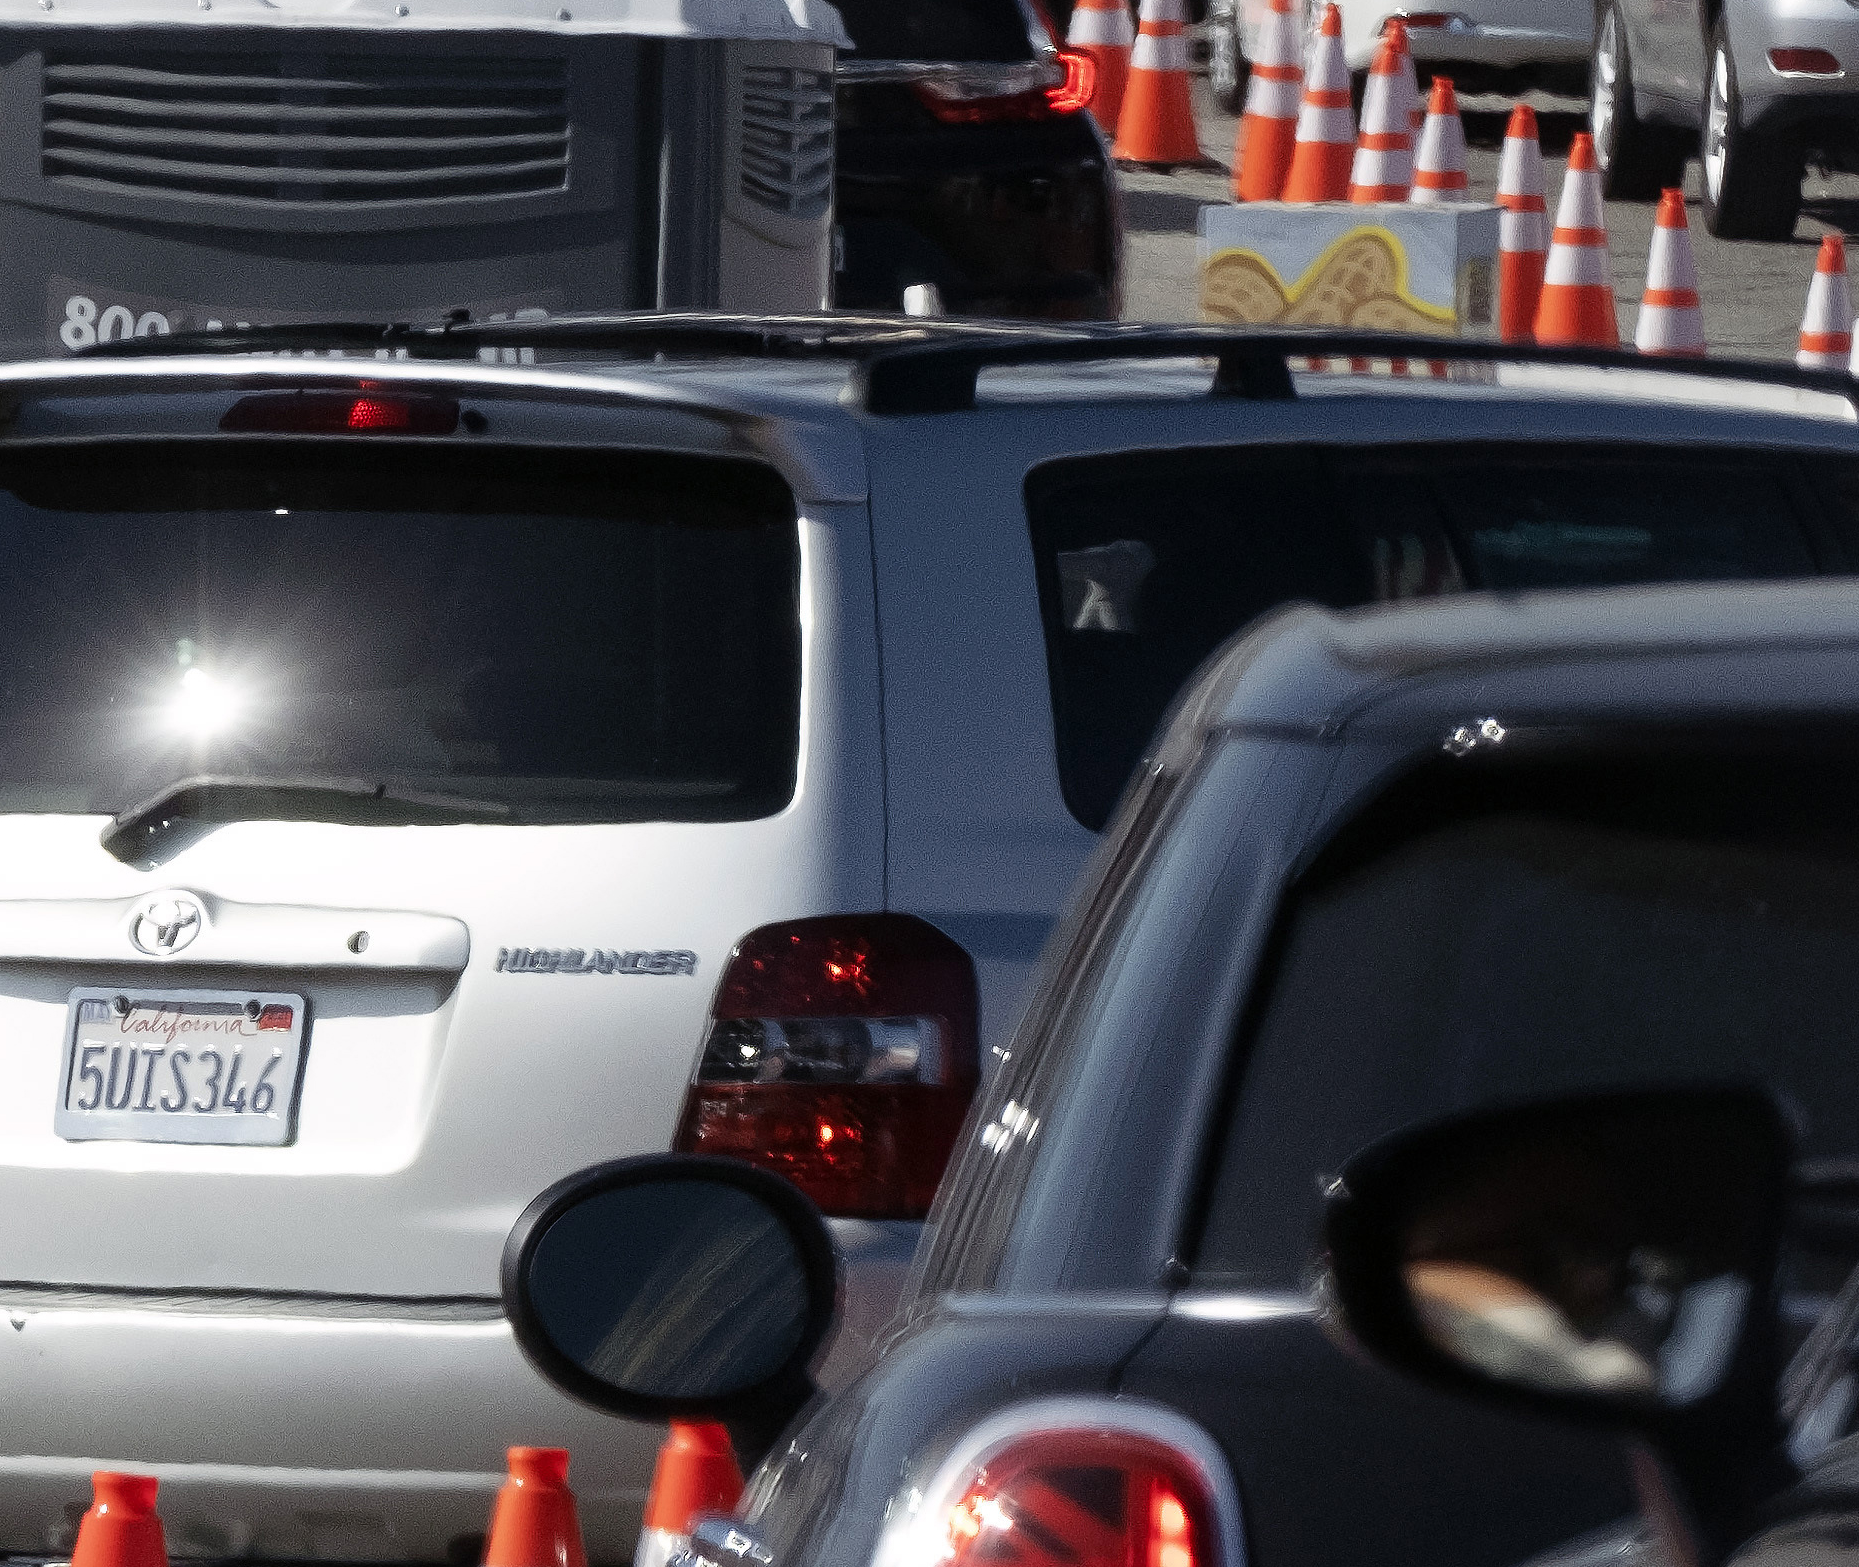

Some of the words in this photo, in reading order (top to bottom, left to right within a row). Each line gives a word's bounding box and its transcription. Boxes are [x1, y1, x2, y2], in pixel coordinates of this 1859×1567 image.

[493, 947, 699, 976] HIGHLANDER
[119, 1003, 257, 1042] California
[77, 1044, 283, 1113] 5UIS346
